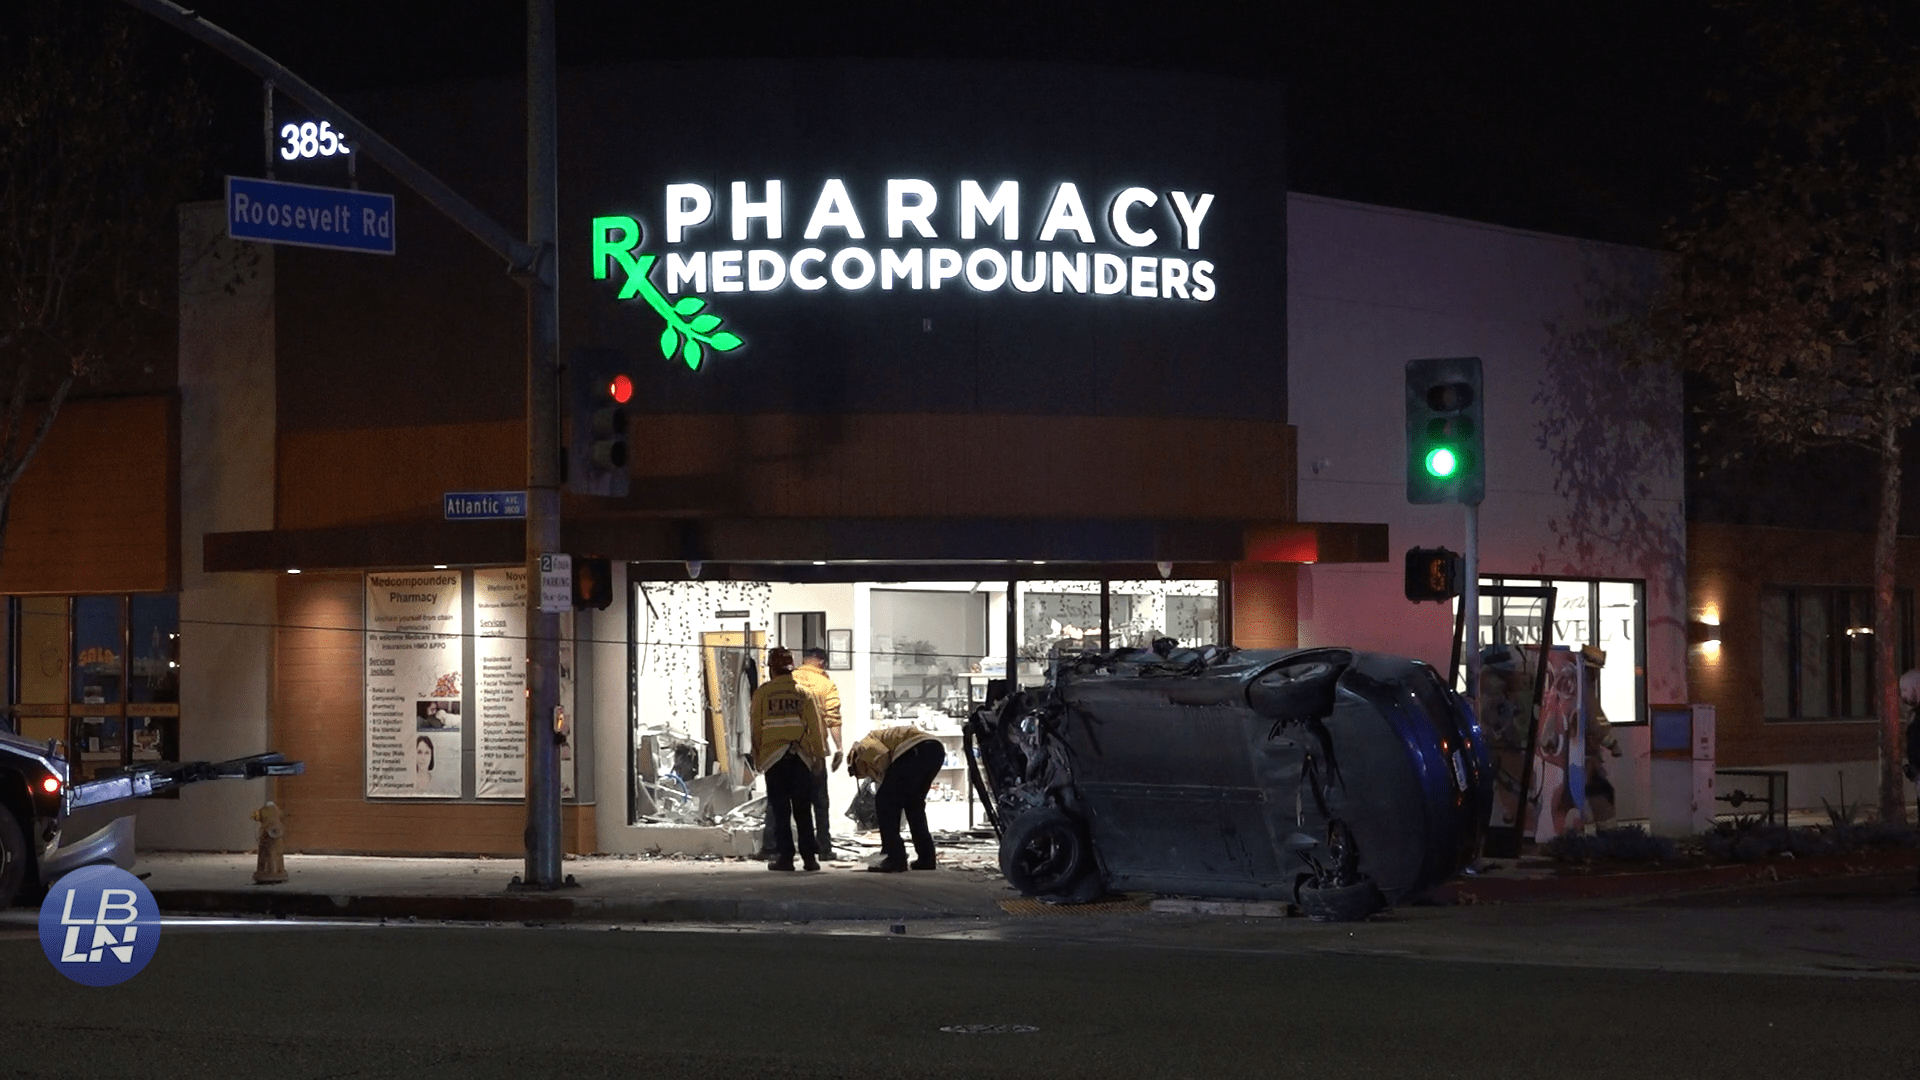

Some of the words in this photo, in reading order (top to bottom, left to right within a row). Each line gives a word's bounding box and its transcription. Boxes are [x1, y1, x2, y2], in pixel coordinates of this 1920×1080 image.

[235, 193, 350, 234] Roosevelt
[363, 207, 390, 238] Rd
[665, 179, 1215, 250] PHARMACY
[666, 248, 1216, 301] MEDCOMPOUNDERS
[447, 498, 499, 514] Atlantic
[543, 557, 551, 570] 2
[370, 575, 457, 587] Medcompounders
[542, 577, 570, 587] PARKING
[389, 592, 438, 605] Pharmacy
[480, 618, 507, 628] Services
[369, 658, 395, 666] Services
[767, 698, 804, 712] FIRE
